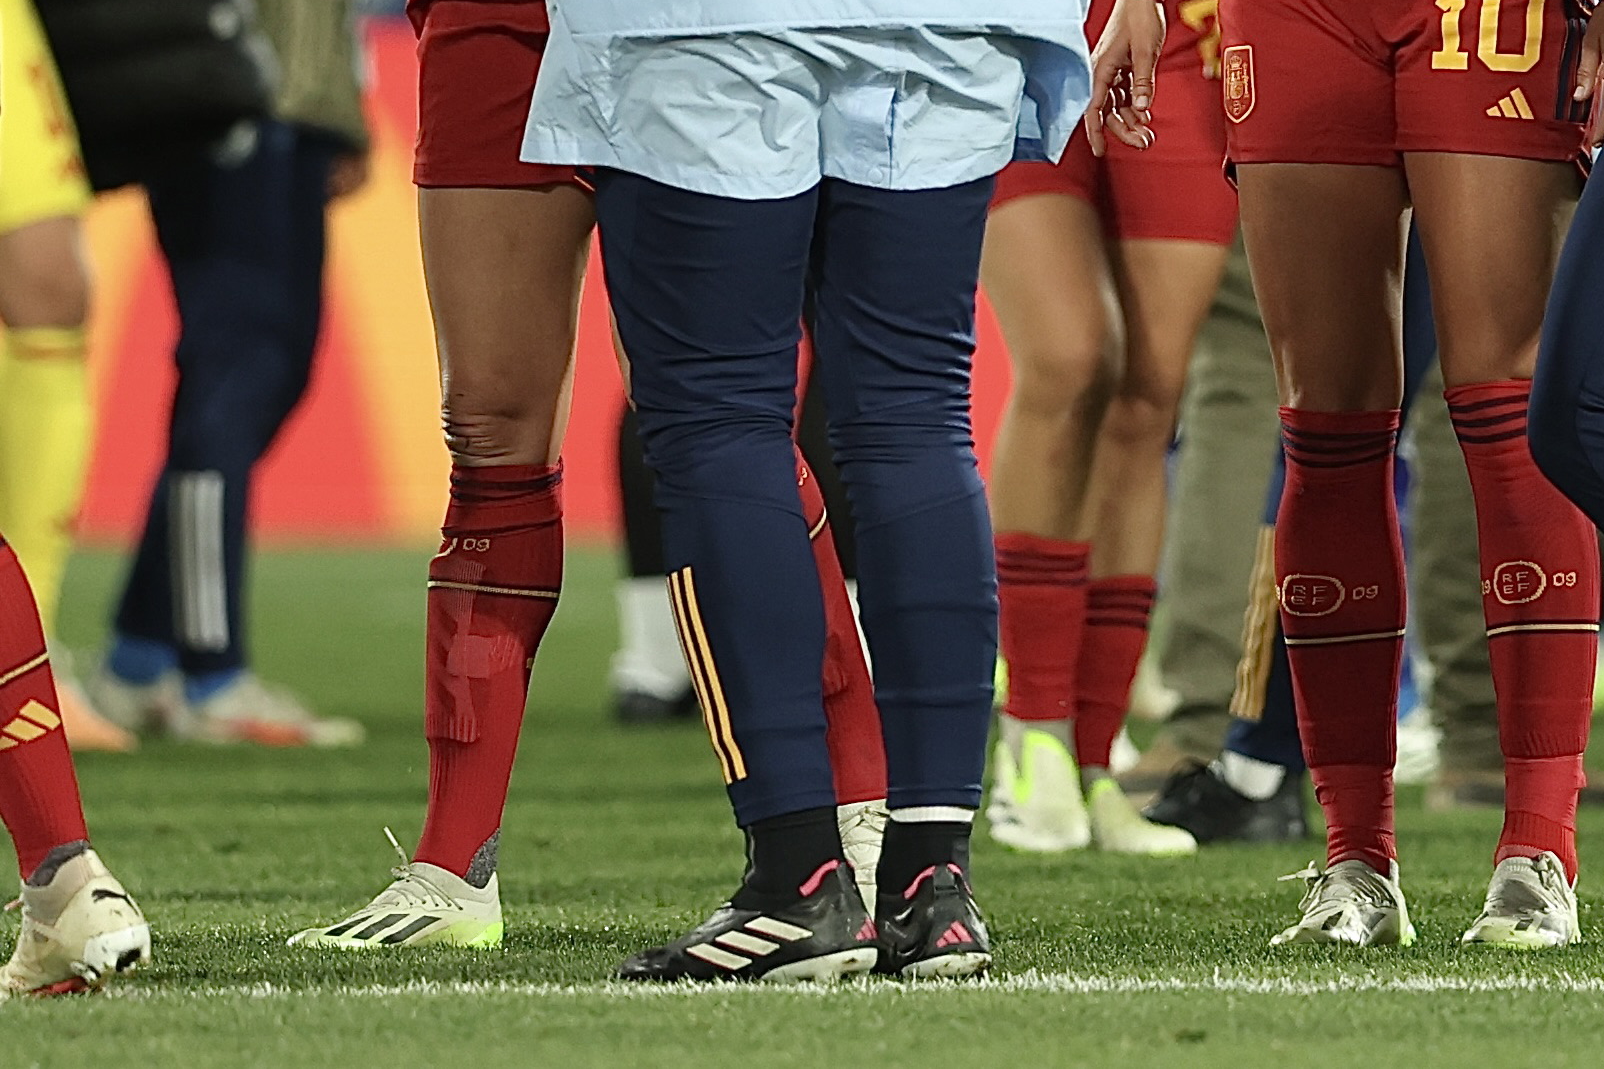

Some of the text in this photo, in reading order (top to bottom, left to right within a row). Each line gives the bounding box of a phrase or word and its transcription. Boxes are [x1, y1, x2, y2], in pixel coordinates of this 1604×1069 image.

[463, 538, 490, 552] 09
[1553, 571, 1577, 587] 09
[1352, 585, 1379, 600] 09
